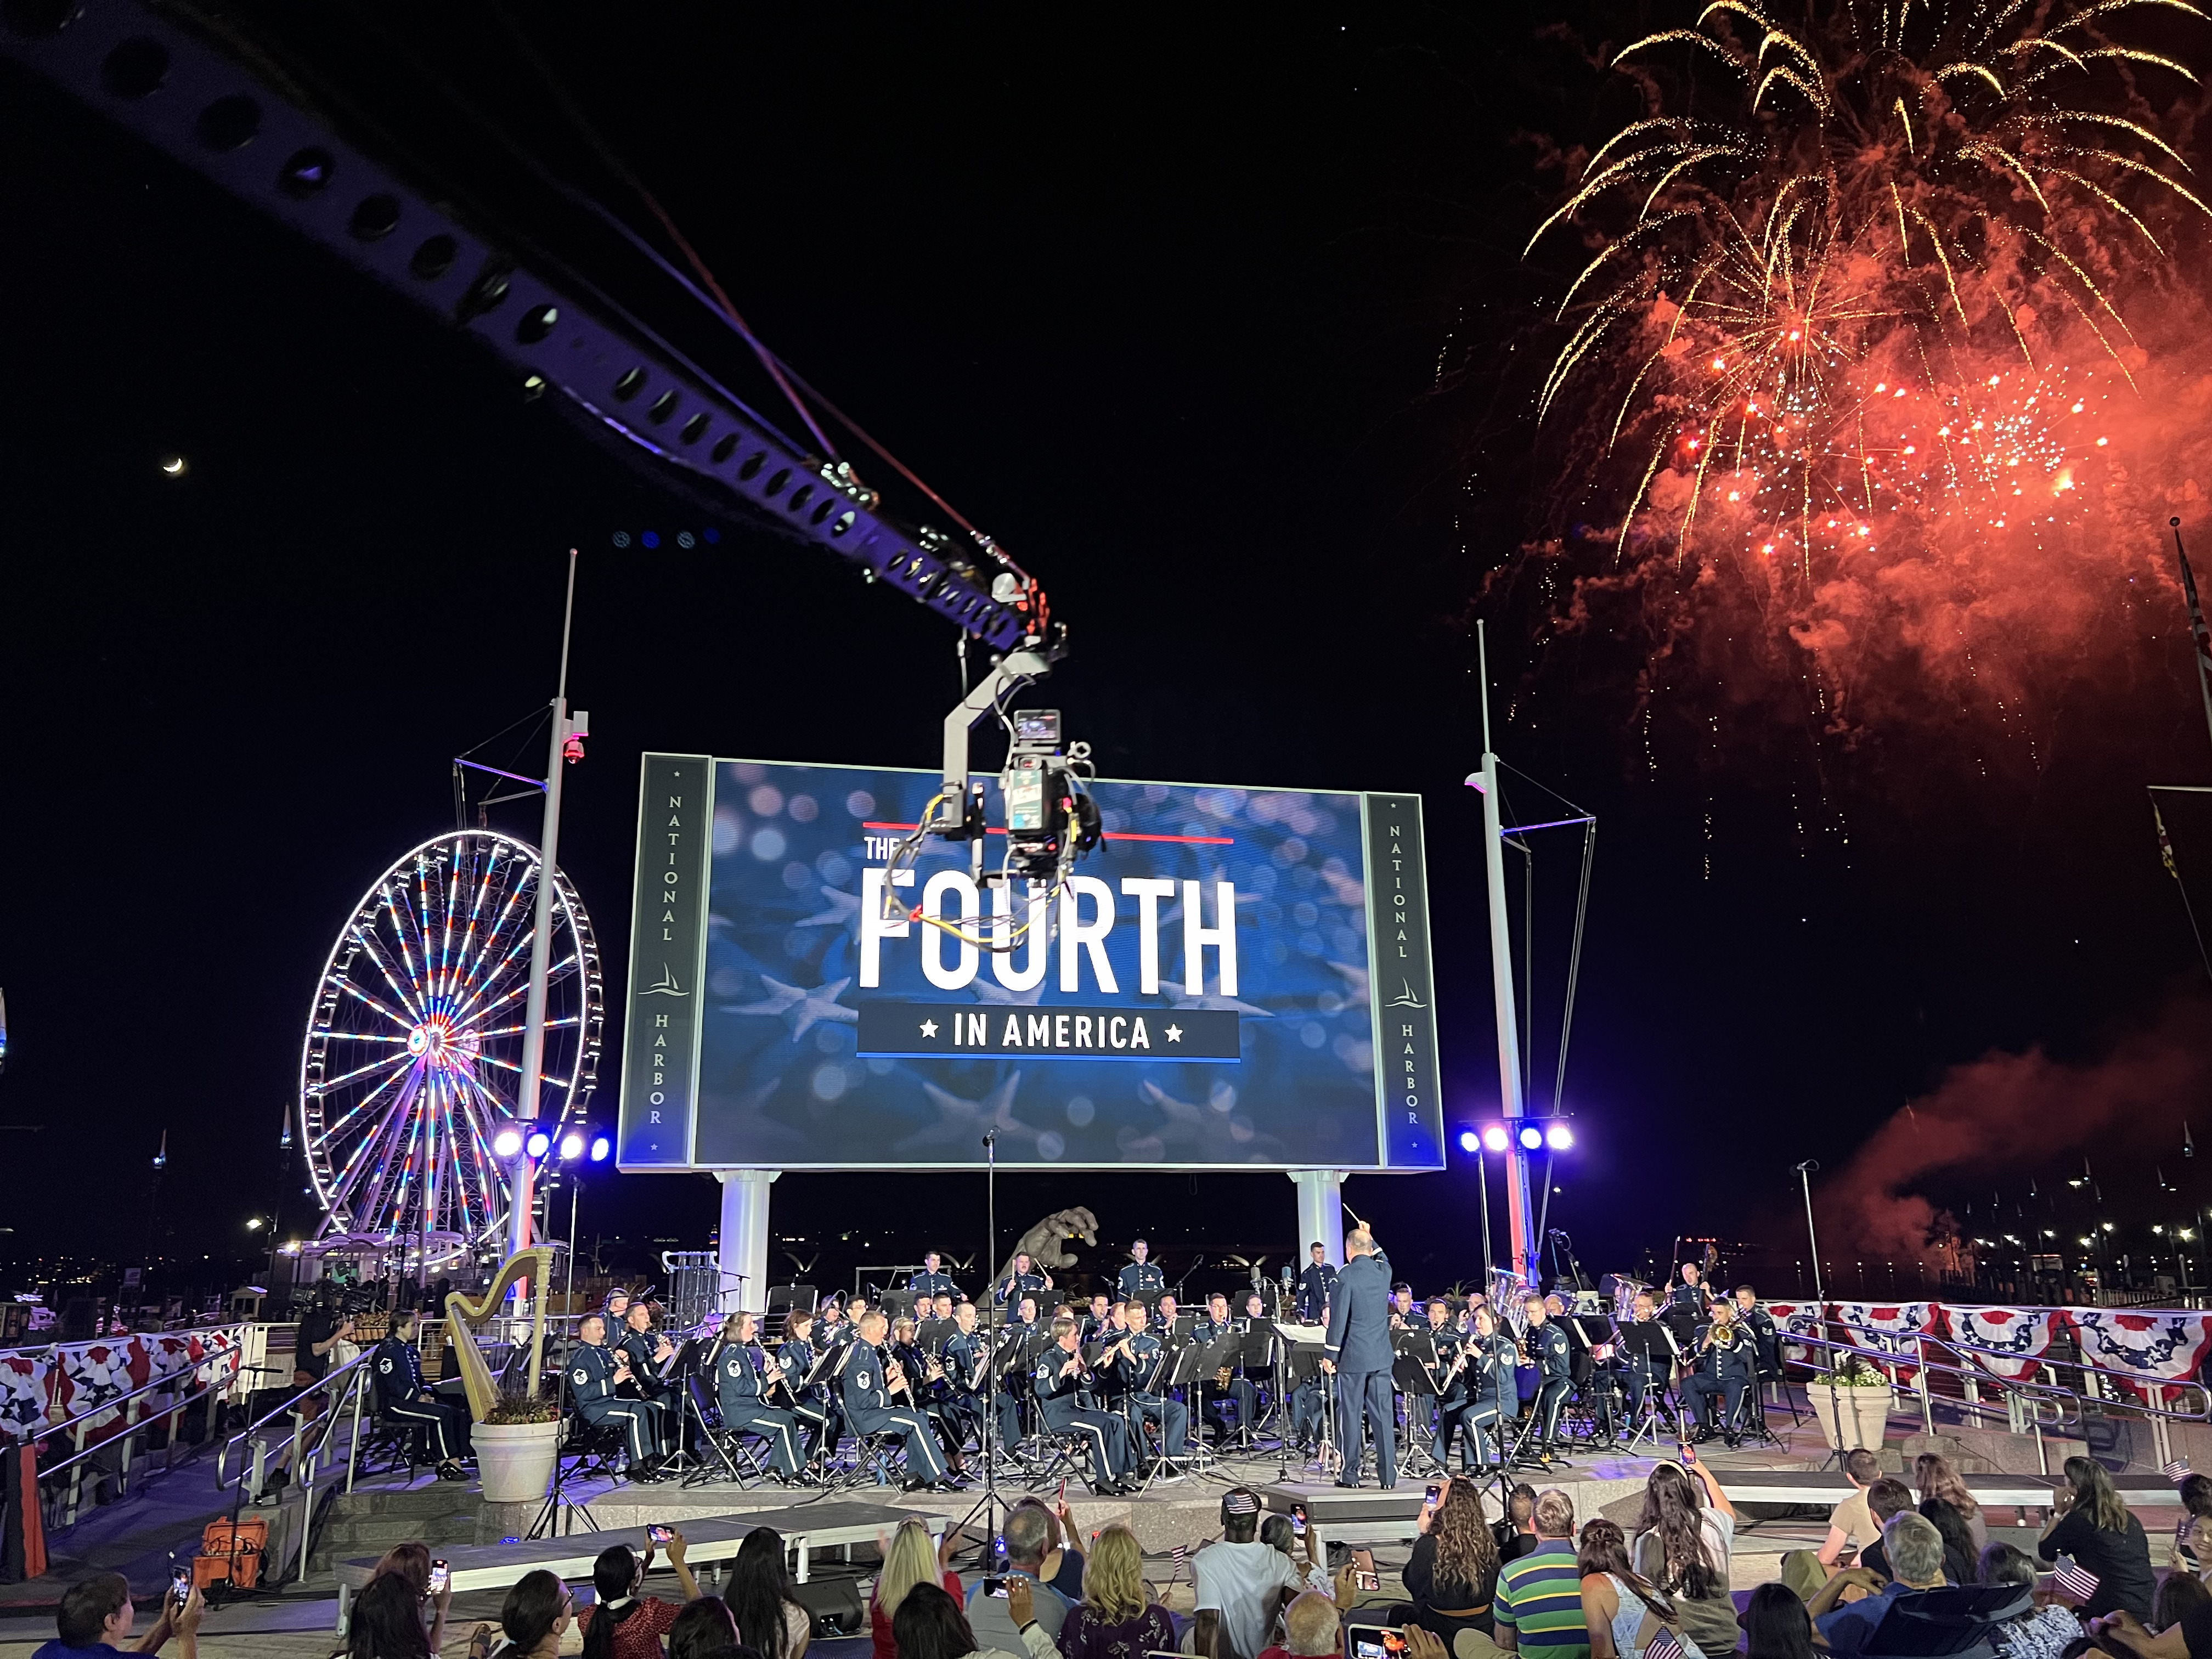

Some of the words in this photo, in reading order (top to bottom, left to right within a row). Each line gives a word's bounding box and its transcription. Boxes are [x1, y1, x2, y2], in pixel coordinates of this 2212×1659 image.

[662, 795, 681, 941] NATIONAL
[859, 867, 1238, 996] FOURTH
[955, 1013, 986, 1046] IN
[1002, 1014, 1150, 1049] AMERICA
[1390, 825, 1407, 957] NATIONAL
[1402, 1024, 1418, 1124] HARBOR
[650, 1014, 669, 1124] HARBOR
